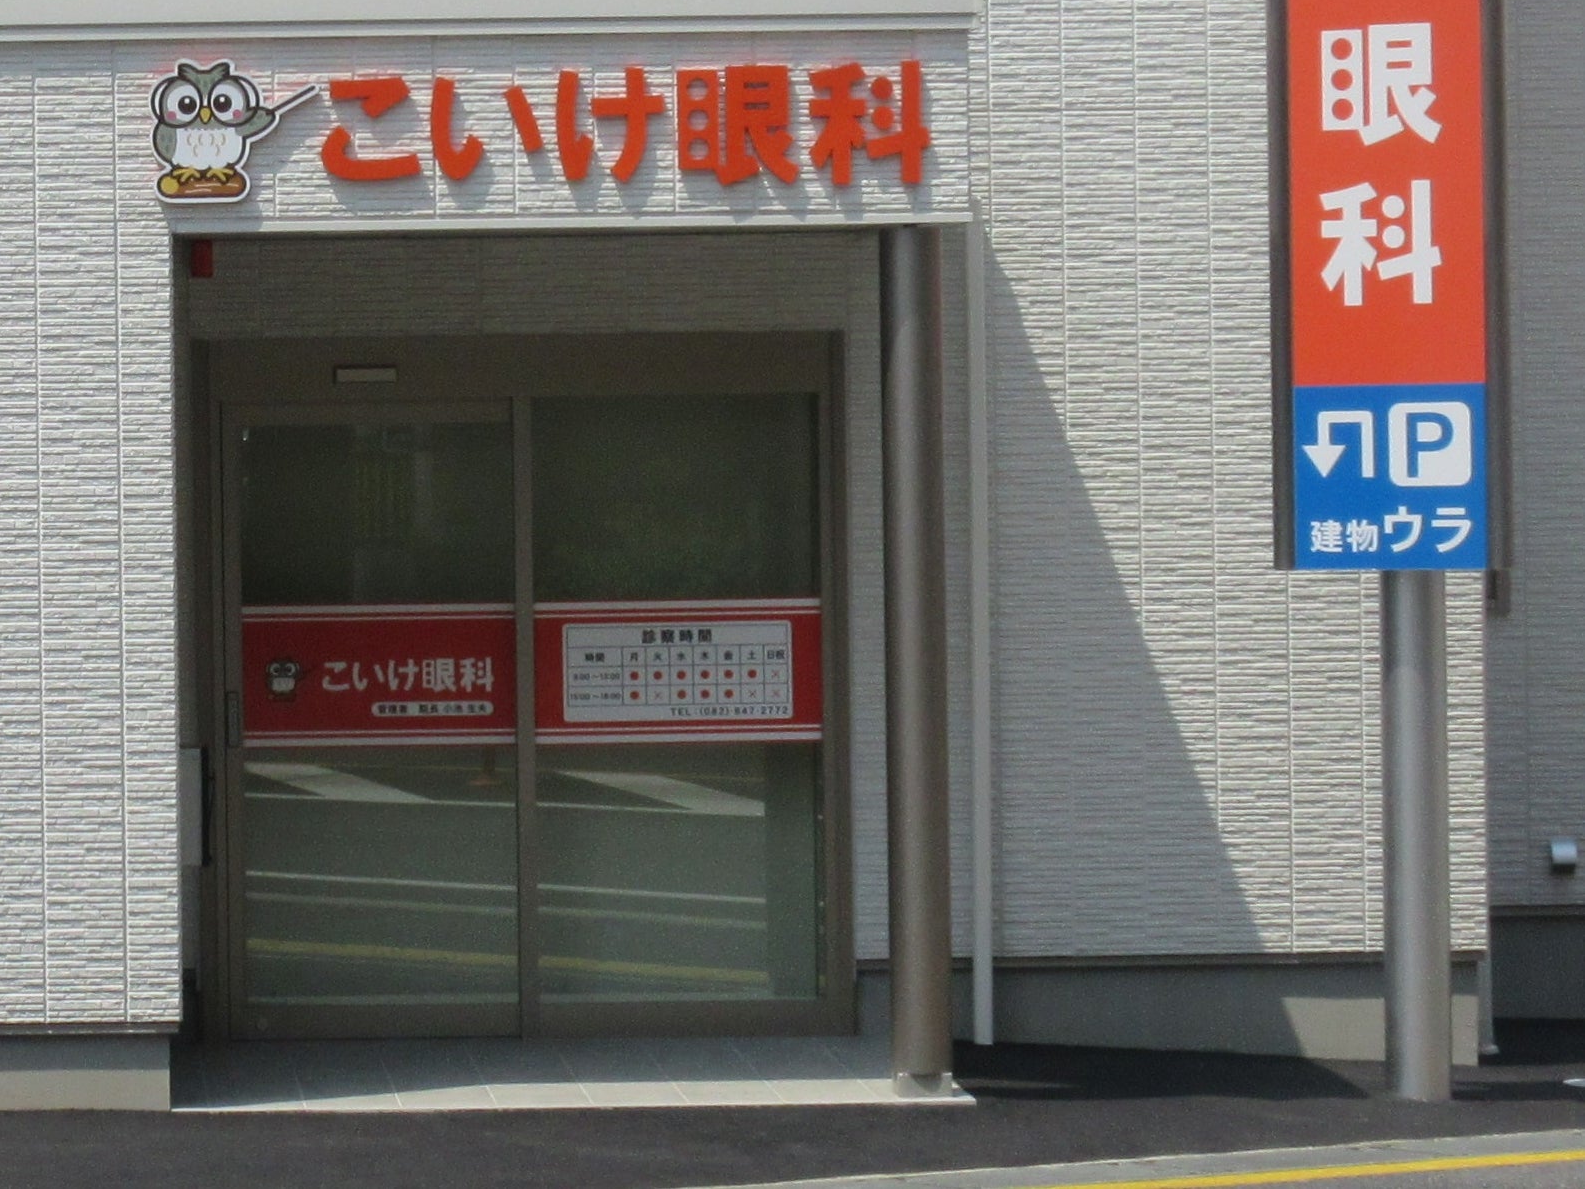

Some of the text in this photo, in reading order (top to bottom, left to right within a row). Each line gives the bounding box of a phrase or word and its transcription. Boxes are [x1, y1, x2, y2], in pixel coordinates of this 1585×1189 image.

[321, 59, 931, 186] こいけ眼科
[1406, 412, 1454, 478] P
[1310, 506, 1472, 553] 建物ウラ
[321, 657, 495, 693] こいけ眼科
